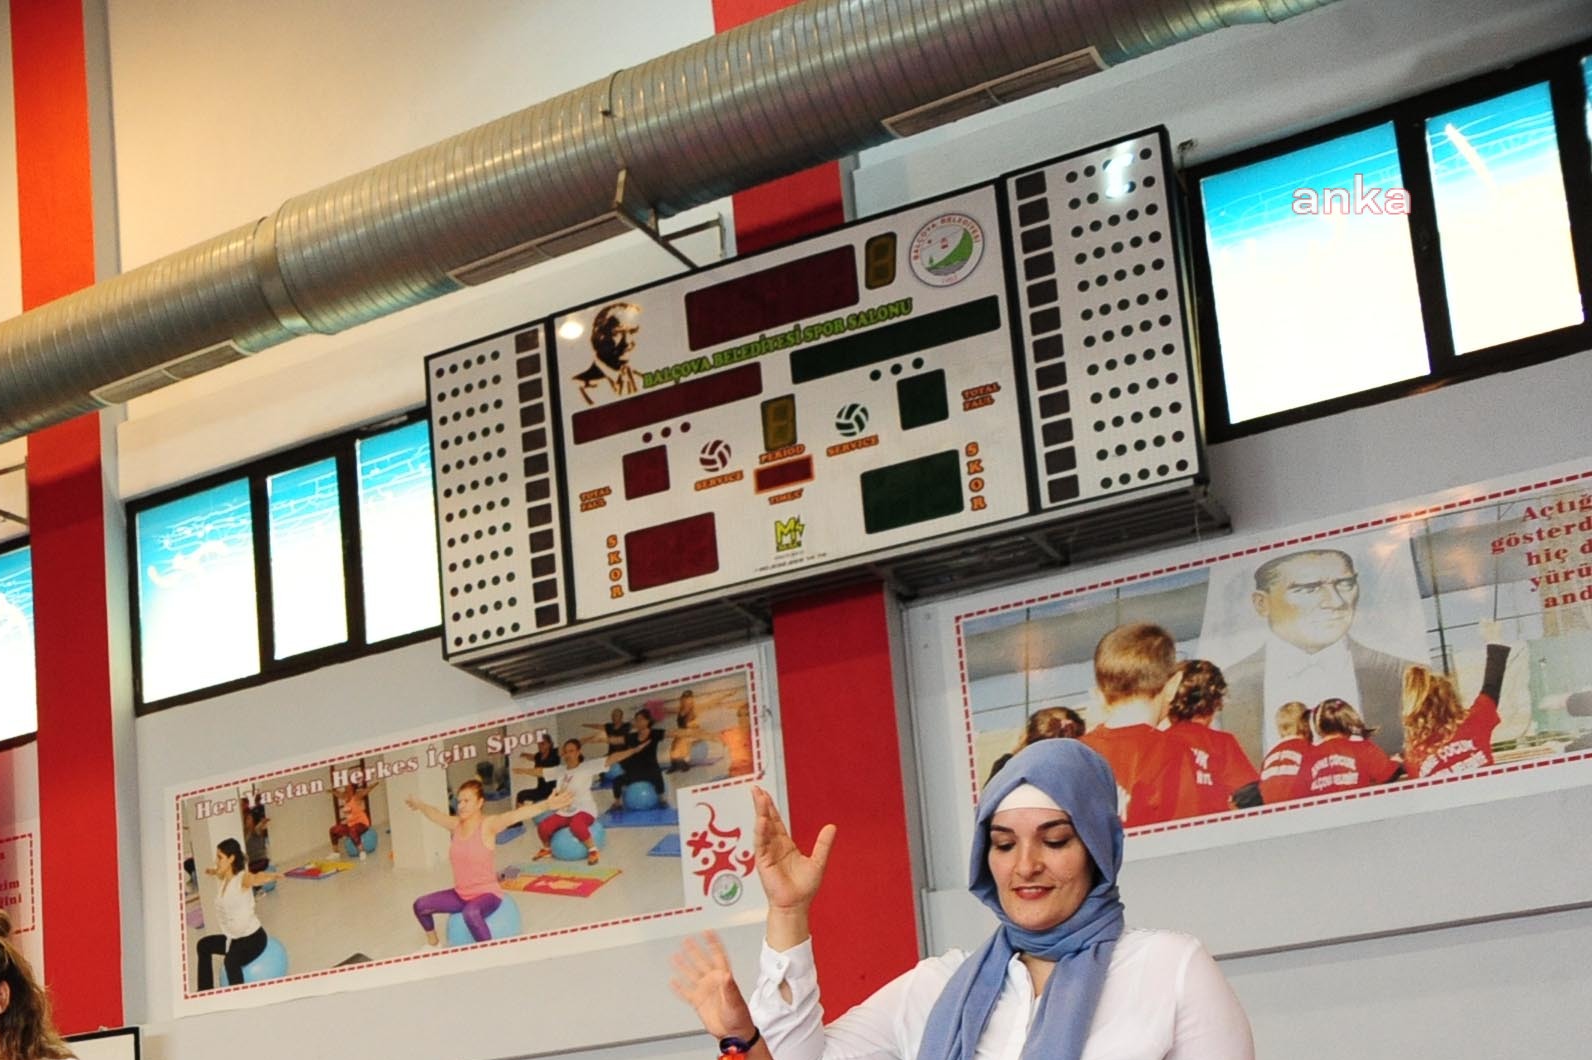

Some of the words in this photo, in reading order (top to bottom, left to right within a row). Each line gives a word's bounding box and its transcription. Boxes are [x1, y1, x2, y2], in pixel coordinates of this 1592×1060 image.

[643, 356, 711, 389] BALÇOVA
[712, 324, 802, 368] BELEDİYESİ
[803, 317, 845, 344] SPOR
[846, 297, 912, 329] SALONU
[826, 434, 879, 457] SERVICE
[694, 470, 744, 492] SERVICE
[1526, 548, 1568, 566] hiç
[195, 799, 237, 821] Her
[242, 779, 324, 808] Yaştan
[332, 757, 418, 788] Herkes
[426, 743, 477, 772] İçin
[487, 728, 548, 757] Spor
